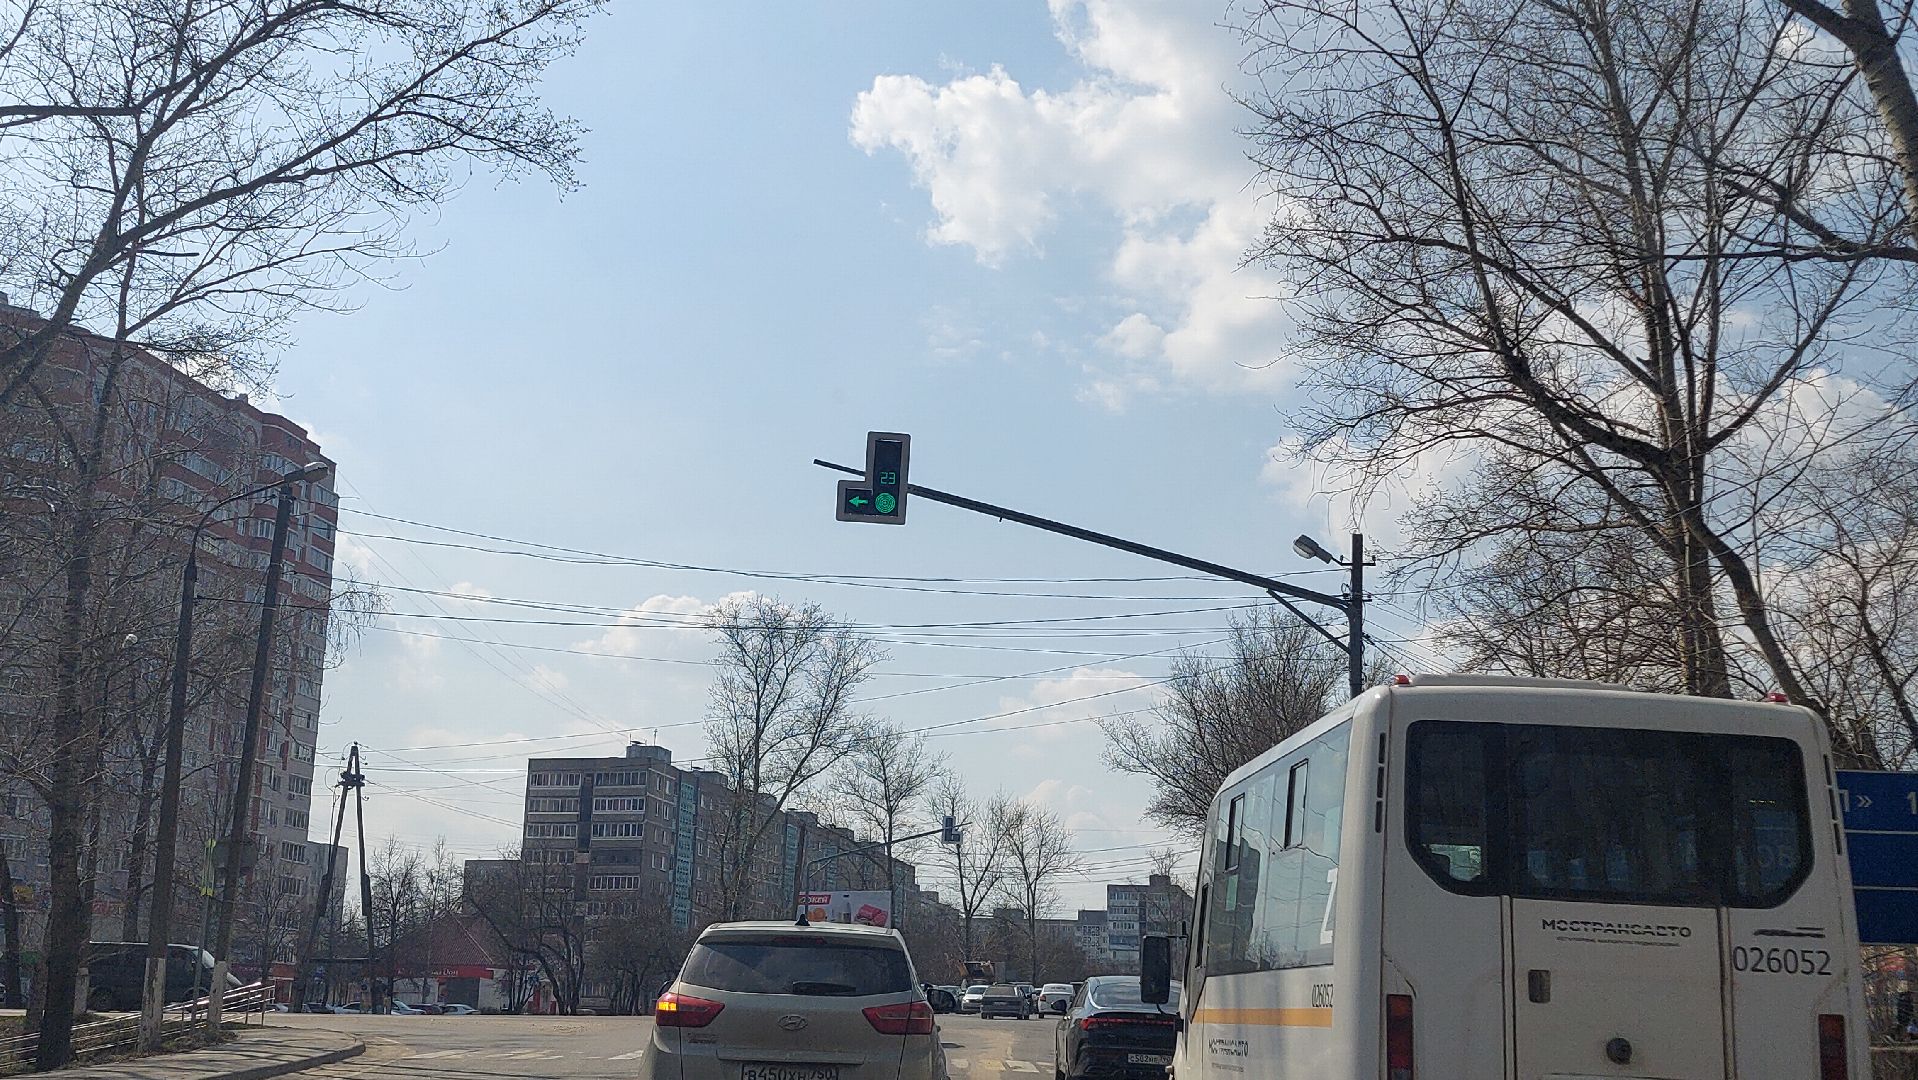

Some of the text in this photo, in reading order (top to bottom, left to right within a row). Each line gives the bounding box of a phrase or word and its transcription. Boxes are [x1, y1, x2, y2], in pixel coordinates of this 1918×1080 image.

[880, 471, 896, 485] 23
[1732, 945, 1833, 976] 026052
[1311, 983, 1334, 1008] 026052
